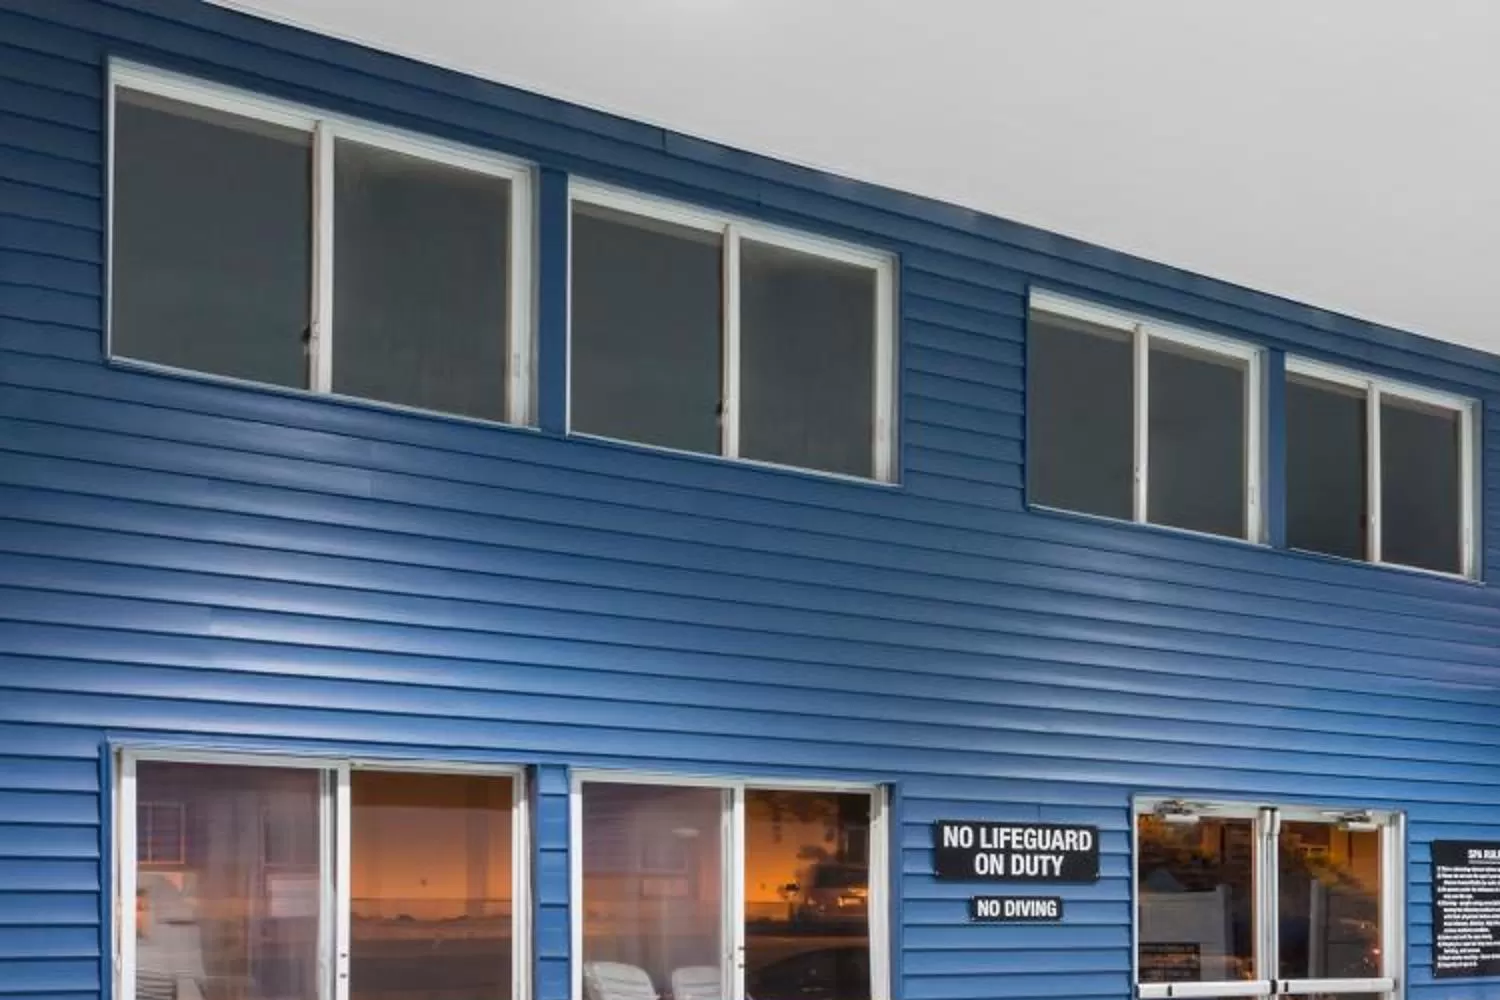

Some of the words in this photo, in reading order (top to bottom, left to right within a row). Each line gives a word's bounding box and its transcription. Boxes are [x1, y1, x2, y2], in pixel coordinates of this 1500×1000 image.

[943, 825, 973, 848] NO
[980, 827, 1092, 851] LIFEGUARD
[974, 852, 1004, 876] ON
[1011, 853, 1065, 876] DUTY
[977, 899, 1000, 917] NO
[1005, 899, 1057, 917] DIVING
